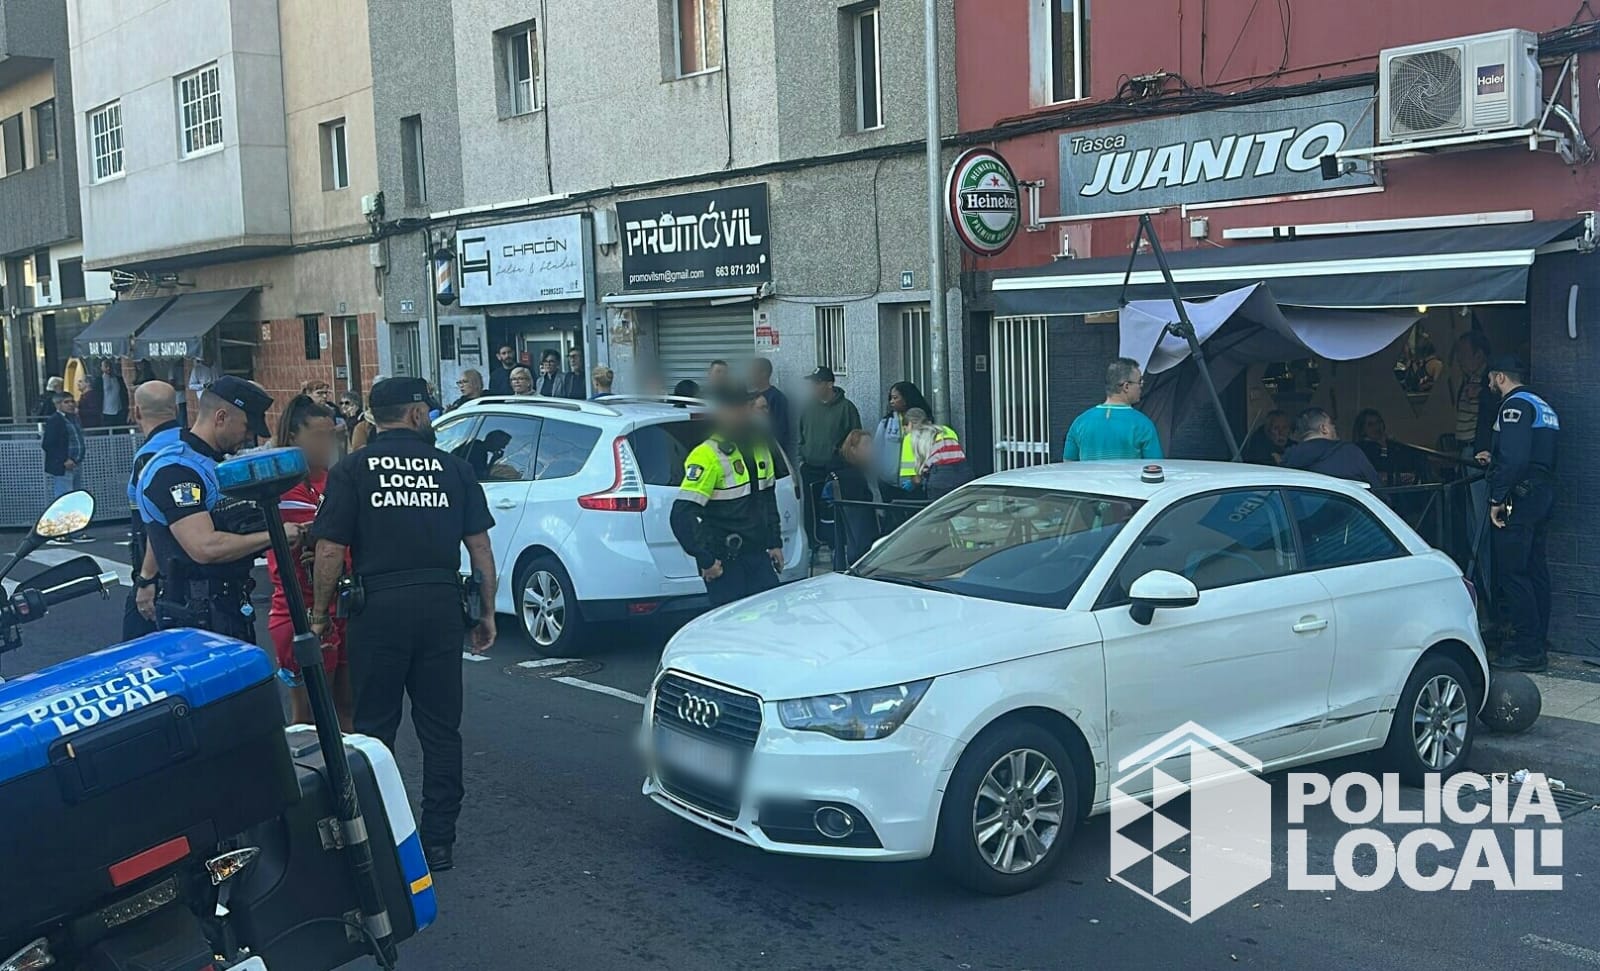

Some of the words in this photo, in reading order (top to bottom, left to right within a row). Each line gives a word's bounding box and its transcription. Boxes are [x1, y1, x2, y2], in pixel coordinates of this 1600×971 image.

[1477, 74, 1505, 86] Haier
[1071, 133, 1126, 155] Tasca
[1079, 120, 1346, 197] JUANITO
[715, 265, 729, 277] 663
[730, 264, 744, 276] 871
[745, 263, 760, 275] 201
[160, 341, 187, 356] SANTIAGO
[367, 456, 443, 471] POLICIA
[379, 474, 440, 489] LOCAL
[370, 491, 450, 508] CANARIA
[51, 684, 168, 735] LOCAL
